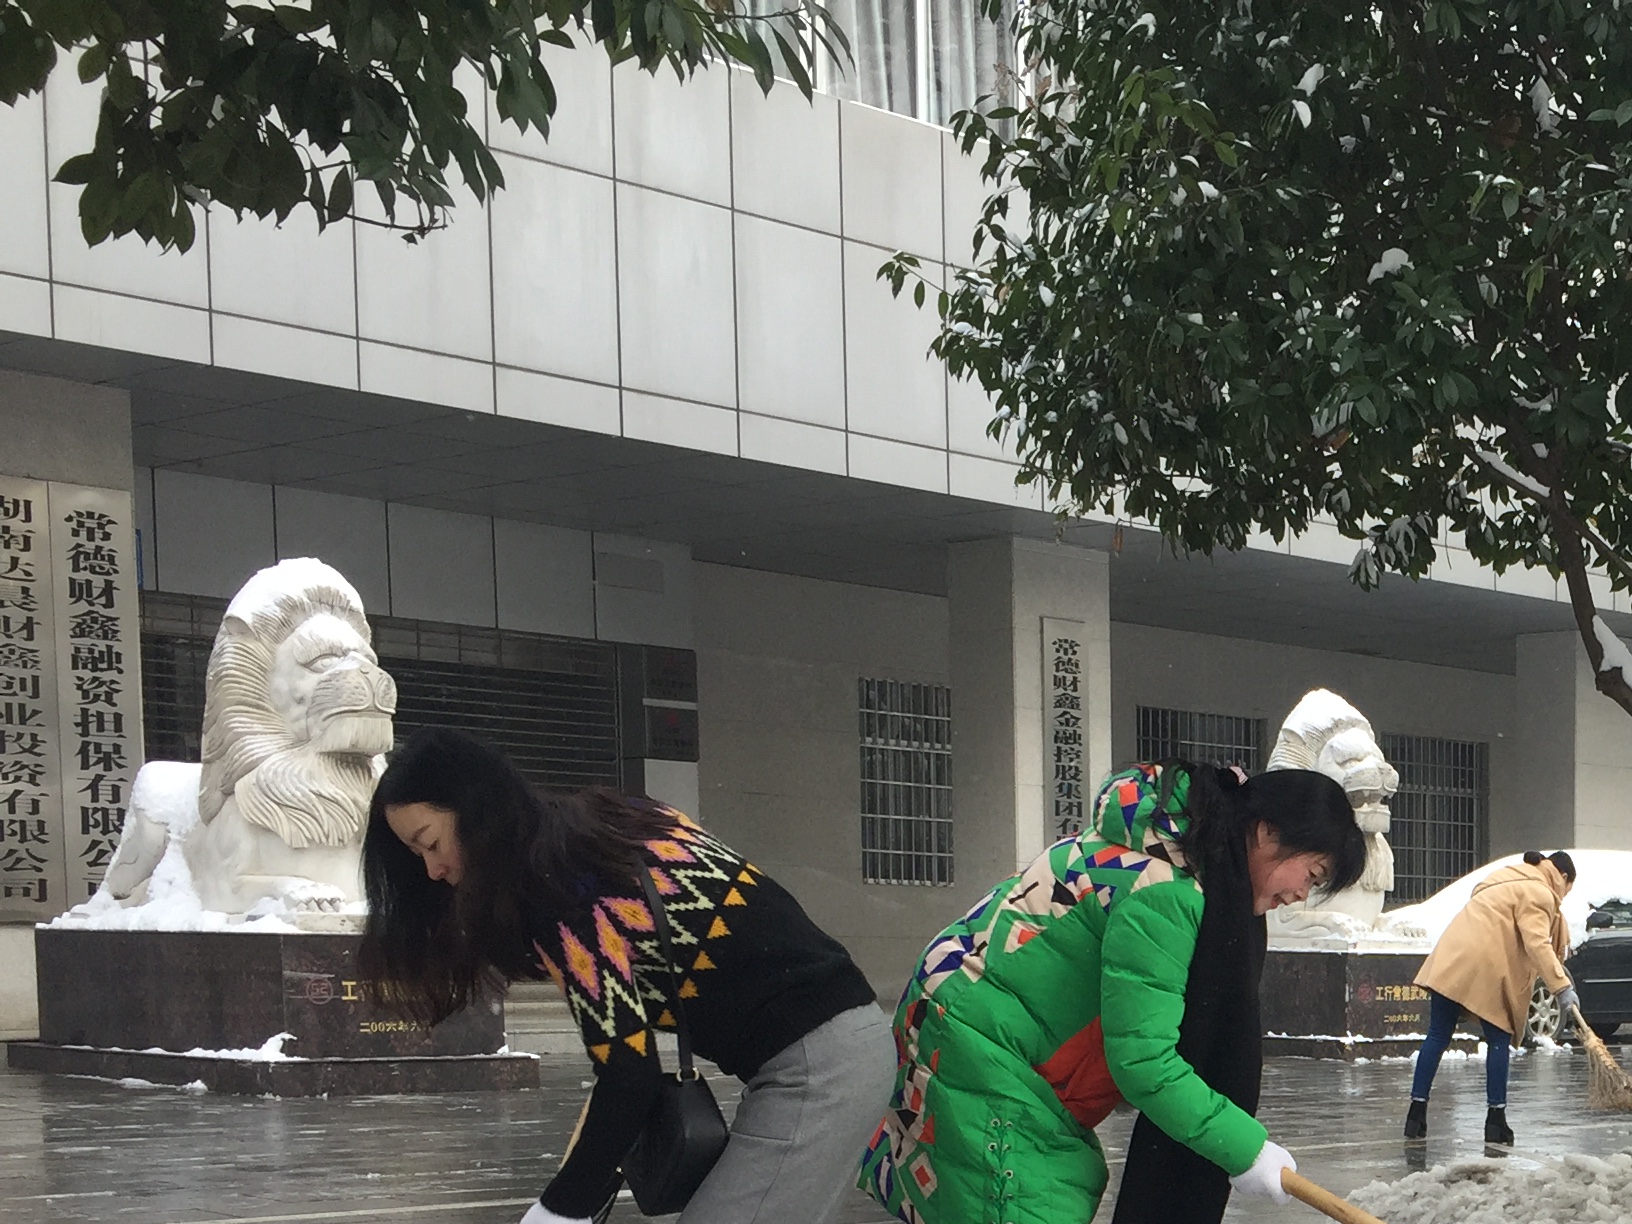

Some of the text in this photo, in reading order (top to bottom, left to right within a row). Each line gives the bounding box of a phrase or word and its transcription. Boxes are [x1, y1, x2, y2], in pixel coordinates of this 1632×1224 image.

[1052, 638, 1082, 841] 常德财鑫金融控股集团有
